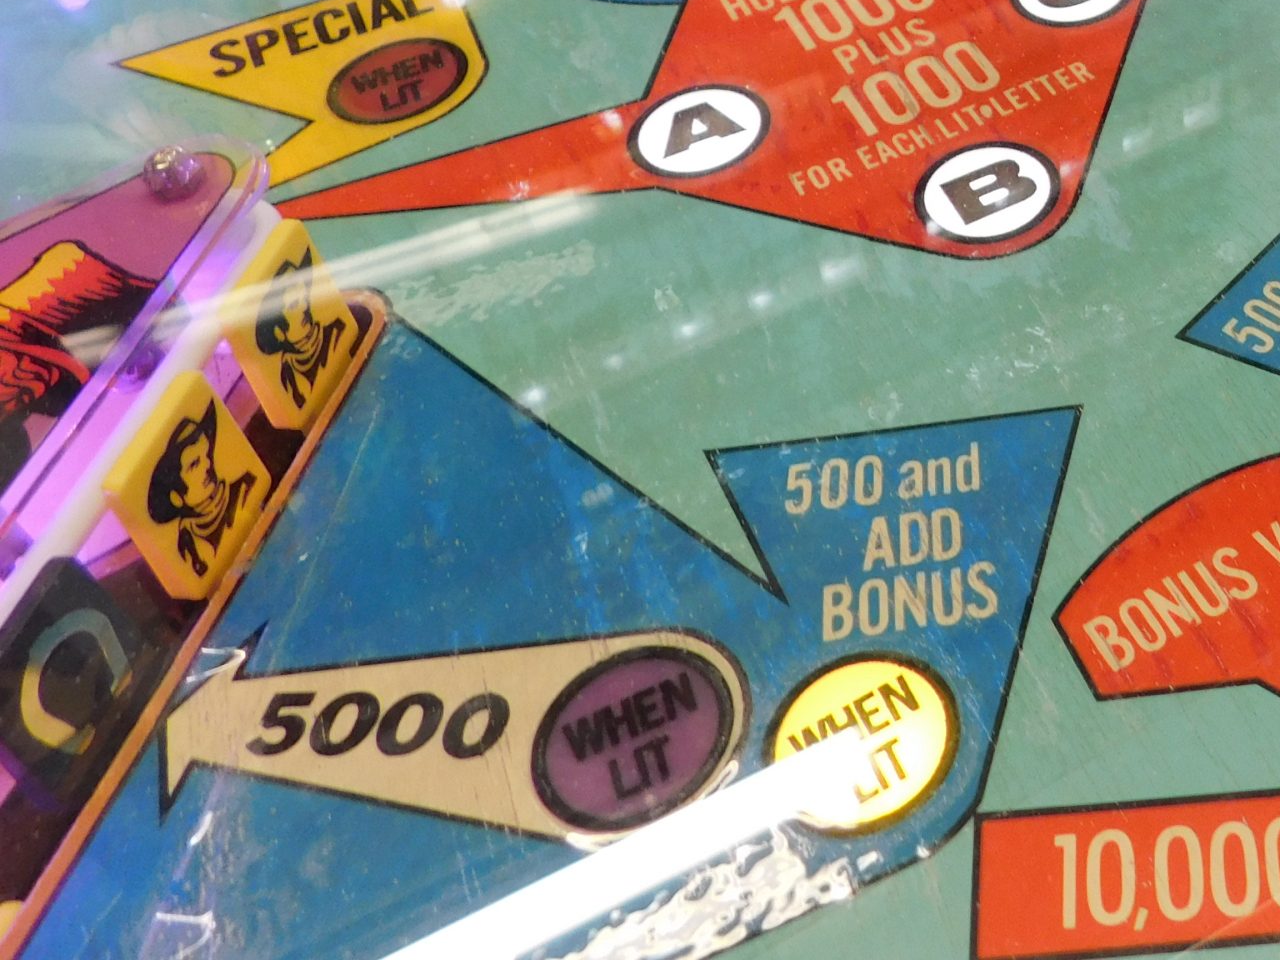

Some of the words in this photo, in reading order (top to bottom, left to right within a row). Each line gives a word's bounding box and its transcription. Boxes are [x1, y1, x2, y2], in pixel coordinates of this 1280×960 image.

[351, 49, 445, 95] WHEN
[832, 17, 937, 75] PLUS
[379, 79, 424, 112] LIT
[831, 41, 1000, 137] 1000
[663, 102, 746, 159] A
[789, 156, 853, 197] FOR
[860, 125, 934, 170] EACH
[938, 157, 1038, 226] B
[784, 455, 883, 515] 500
[898, 442, 981, 500] and
[863, 507, 962, 572] ADD
[822, 561, 999, 642] BONUS
[1082, 547, 1259, 673] BONUS
[245, 690, 511, 760] 5000
[562, 671, 698, 762] WHEN
[605, 738, 672, 798] LIT
